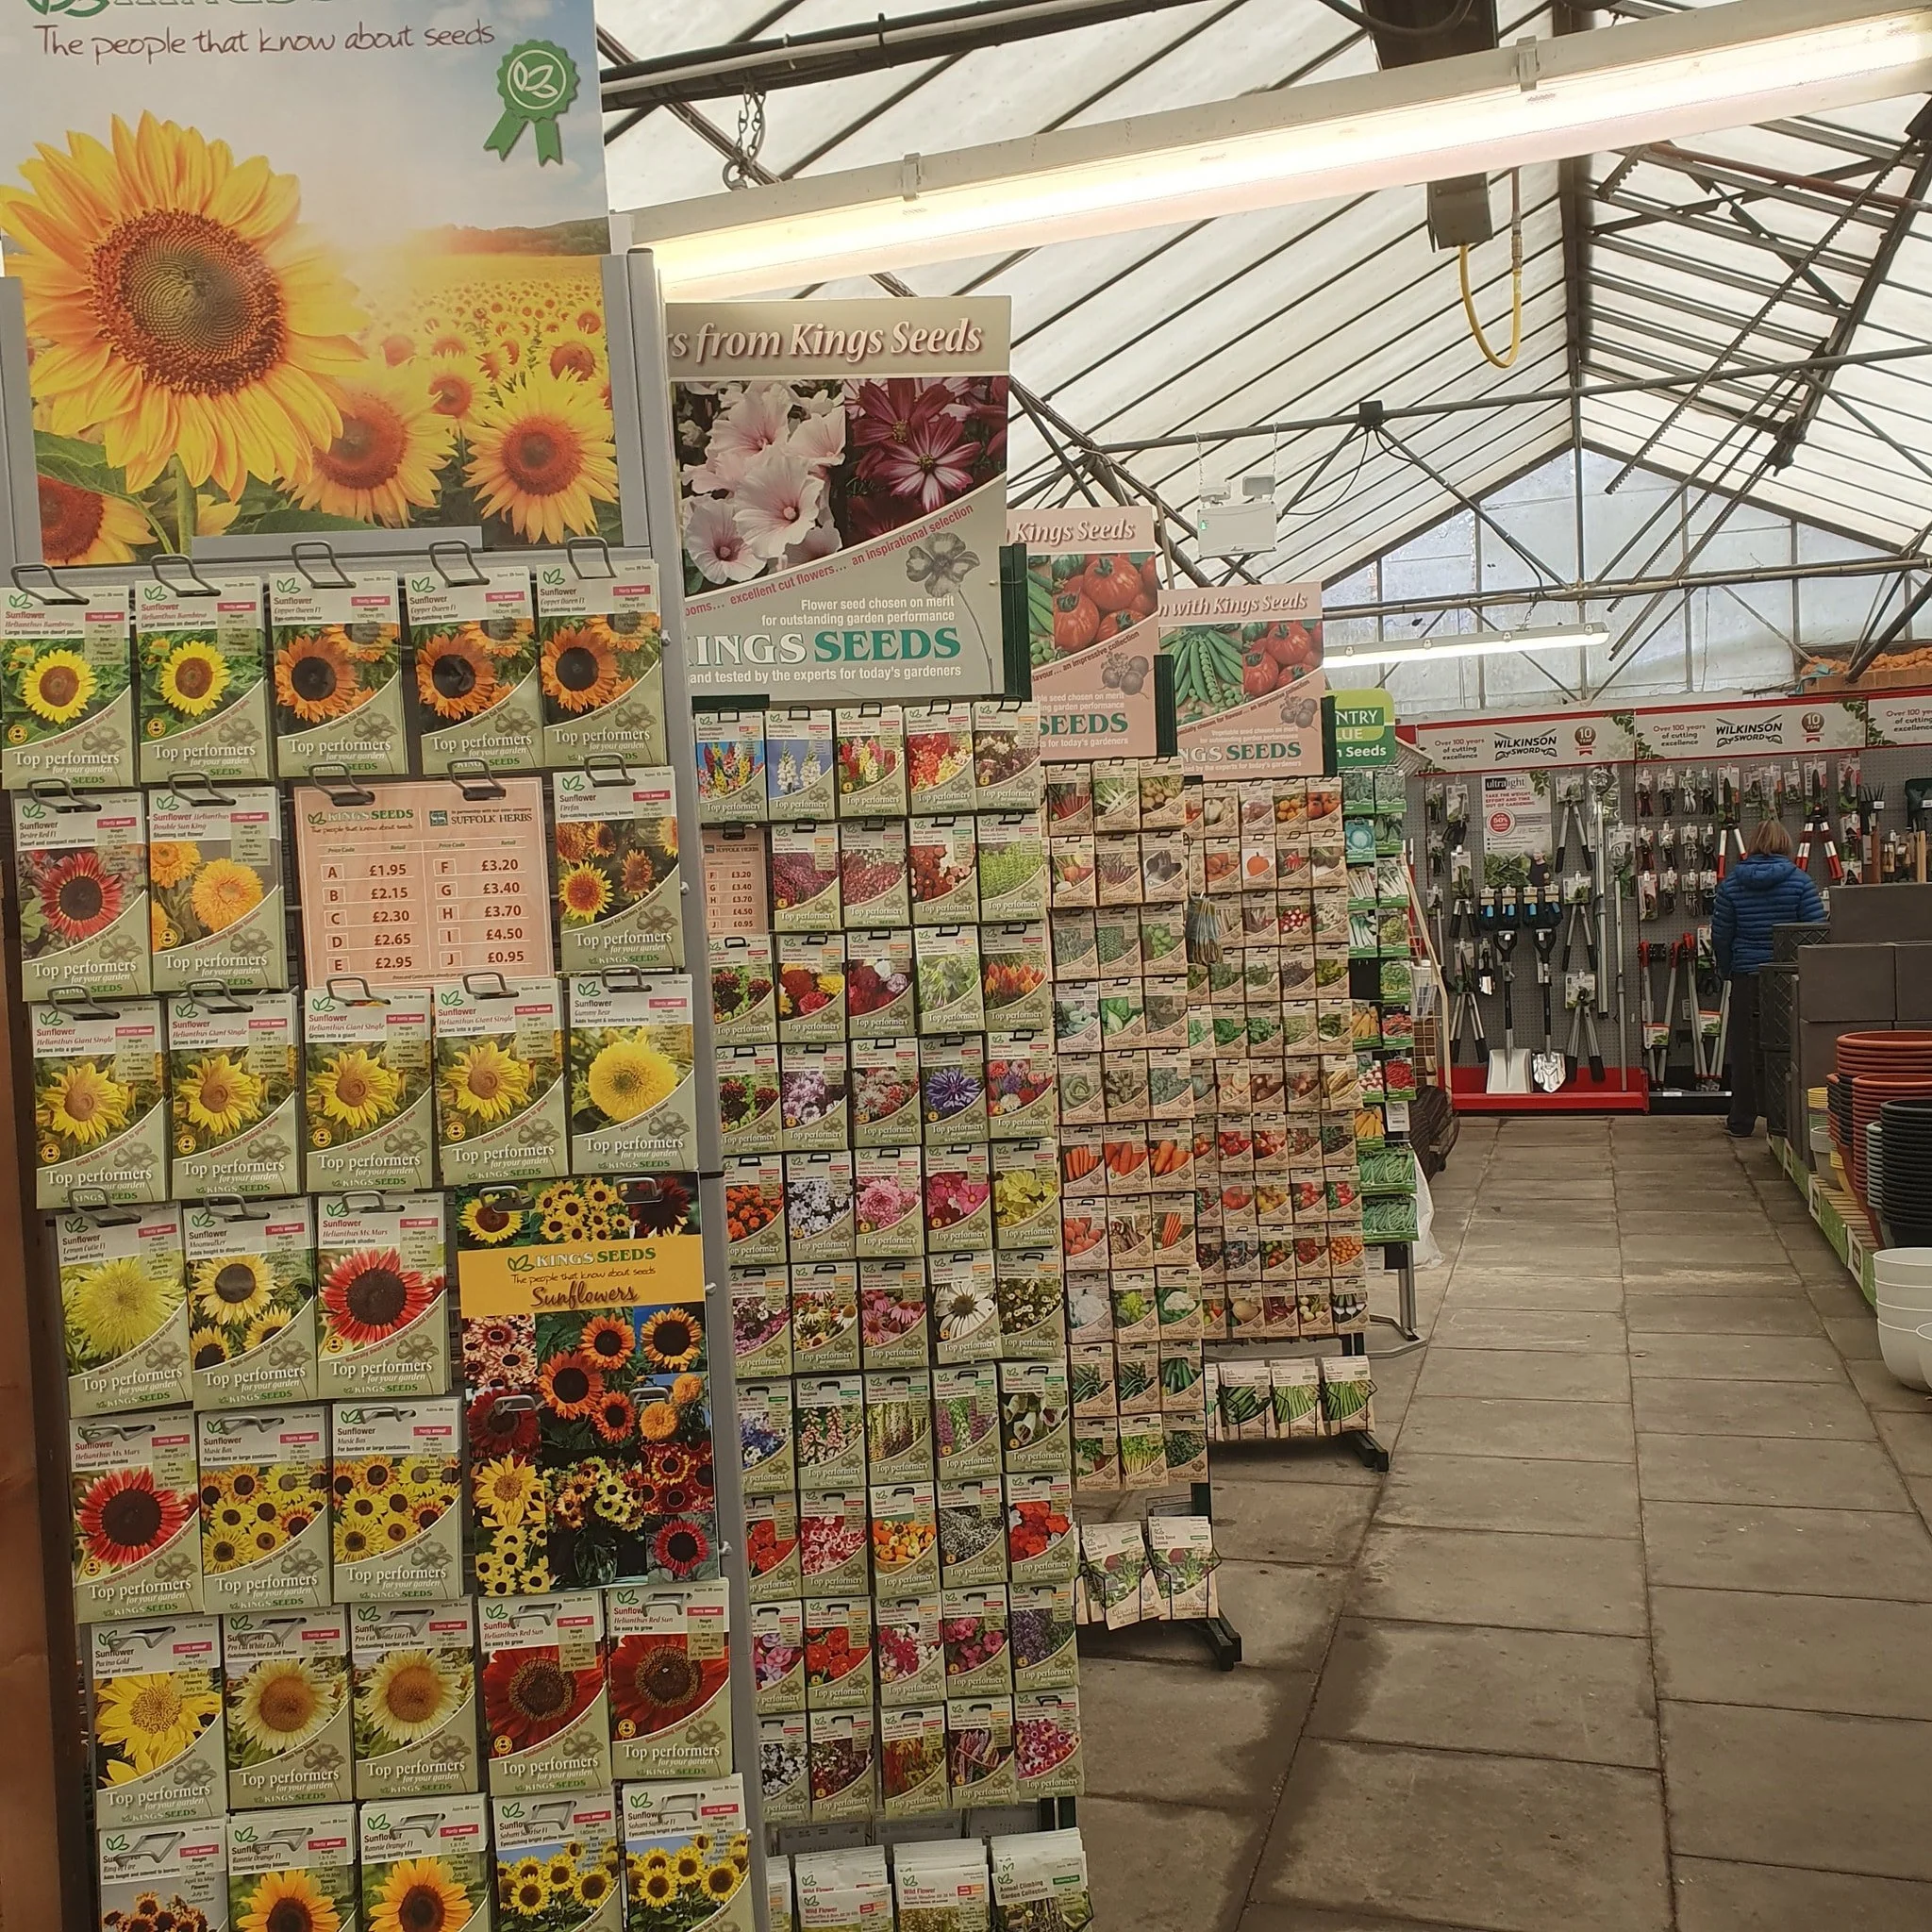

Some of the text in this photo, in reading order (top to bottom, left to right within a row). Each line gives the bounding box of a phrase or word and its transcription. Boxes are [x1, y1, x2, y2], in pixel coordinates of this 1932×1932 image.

[33, 20, 495, 65] The people that know about seeds
[696, 323, 781, 363] from
[789, 323, 884, 362] Kings
[891, 318, 982, 356] Seeds
[1015, 519, 1136, 543] Kings Seeds
[730, 584, 776, 606] excellent
[777, 576, 795, 591] cut
[852, 555, 865, 566] an
[866, 526, 928, 560] inspirational
[929, 505, 974, 534] selection
[540, 587, 577, 597] Sunflower
[142, 602, 179, 610] Sunflower
[801, 595, 955, 611] Flower seed chosen on merit
[1173, 592, 1307, 617] with Kings Seeds
[761, 609, 955, 627] for outstanding garden performance
[689, 627, 961, 666] INGS SEEDS
[1072, 648, 1108, 667] impressive
[1108, 631, 1140, 651] collection
[690, 663, 961, 684] and tested by the experts for today's gardeners
[1054, 702, 1124, 712] garden performance
[1040, 712, 1128, 735] SEEDS
[1806, 714, 1820, 724] 10
[555, 726, 650, 745] Top performers
[1579, 728, 1592, 738] 10
[1716, 723, 1782, 735] WILKINSON
[1060, 739, 1088, 747] today's
[1091, 738, 1128, 747] gardeners
[1226, 741, 1301, 761] SEEDS
[1346, 744, 1387, 757] Seeds
[1494, 736, 1557, 748] WILKINSON
[1249, 761, 1270, 770] today's
[1487, 777, 1525, 789] ultralight
[328, 809, 413, 822] KINGS SEEDS
[451, 813, 532, 824] SUFFOLK HERBS
[328, 859, 518, 878] A £1.95 F £3.20
[330, 882, 520, 901] B £2.15 G £3.40
[331, 905, 522, 924] C £2.30 H £3.70
[332, 937, 341, 948] D
[375, 933, 410, 945] £2.65
[486, 928, 523, 941] £4.50
[574, 930, 673, 949] Top performers
[334, 951, 525, 971] E £2.95 J £0.95
[997, 1116, 1052, 1128] Top performers
[536, 1247, 657, 1268] KINGS SEEDS
[511, 1266, 657, 1287] The people that know about seeds
[531, 1281, 638, 1309] Sunflowers
[329, 1358, 432, 1378] Top performers
[623, 1743, 720, 1761] Top performers
